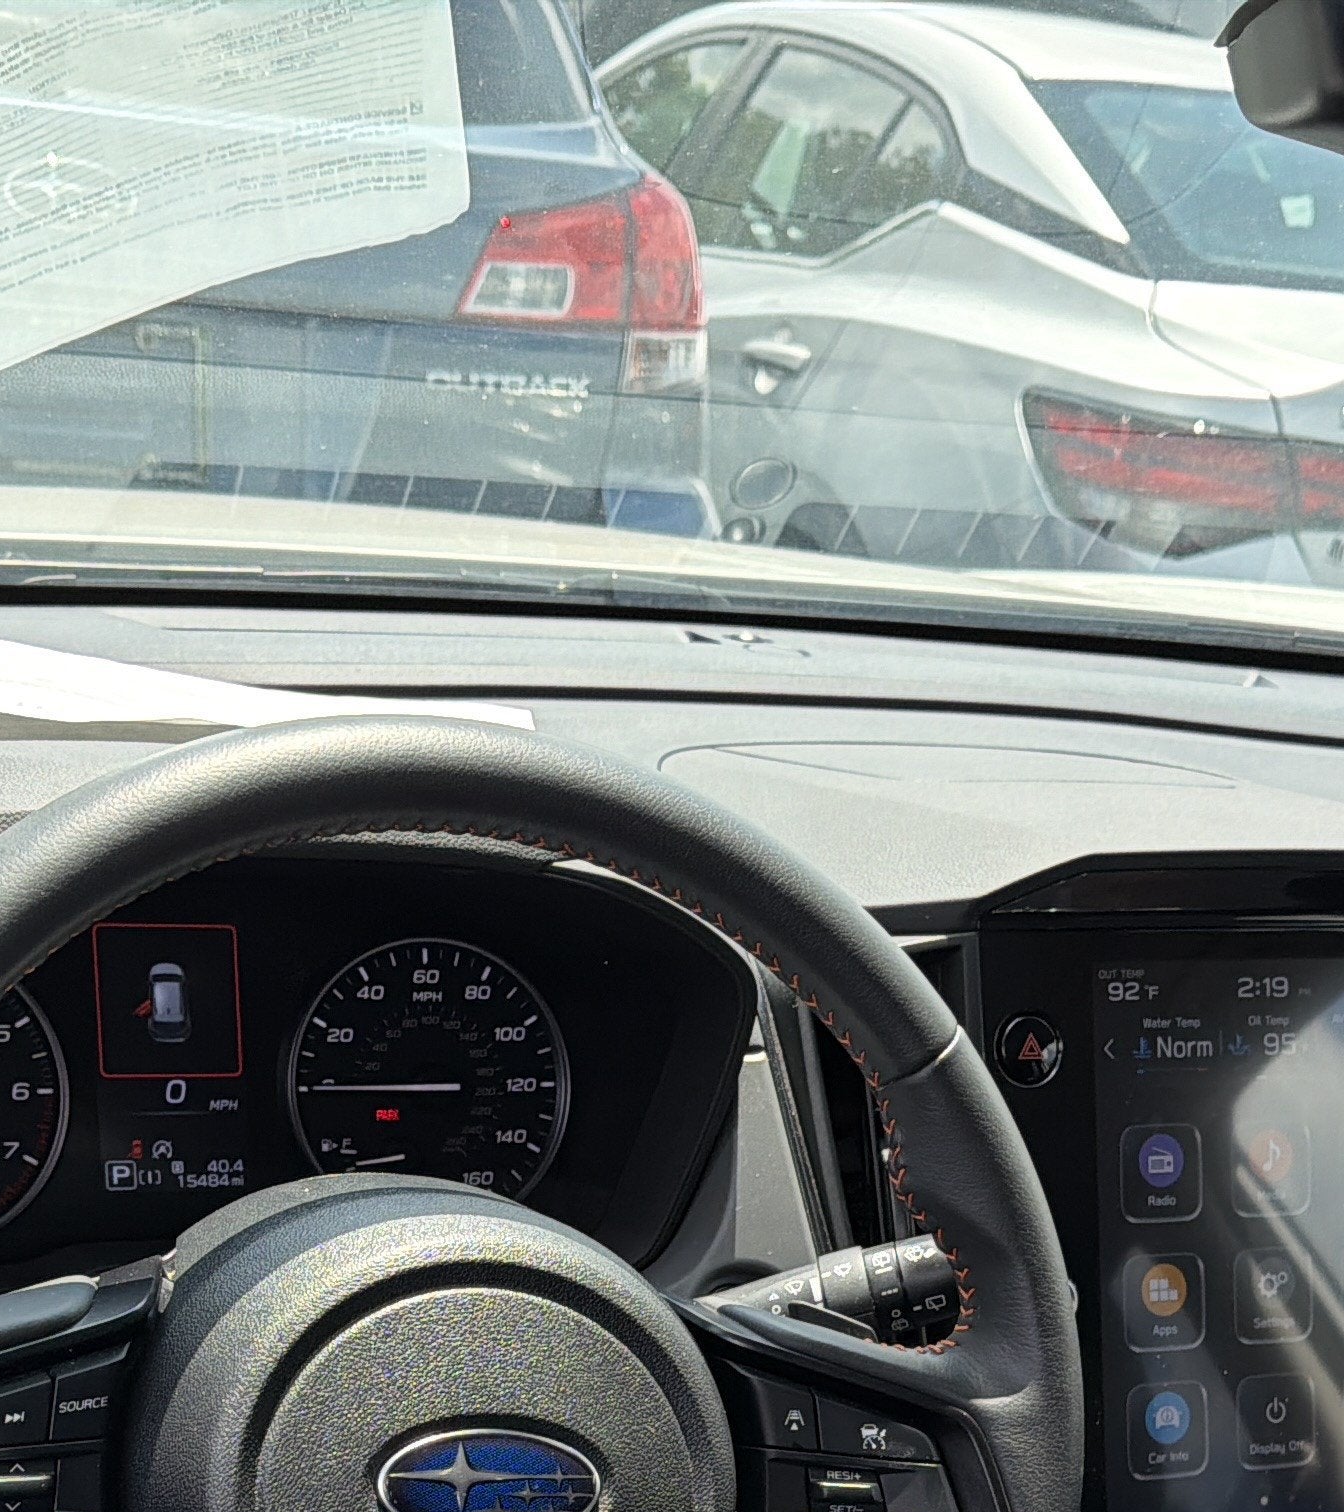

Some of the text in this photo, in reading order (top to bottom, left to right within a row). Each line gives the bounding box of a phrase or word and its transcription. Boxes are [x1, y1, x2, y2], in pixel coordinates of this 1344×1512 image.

[413, 969, 440, 984] 60
[1121, 968, 1146, 979] TEMP
[357, 985, 385, 1000] 40
[465, 985, 492, 1000] 80
[1107, 982, 1140, 1002] 92
[1237, 976, 1290, 998] 2:19
[413, 991, 443, 1003] MPH
[1142, 1017, 1201, 1030] Water Temp
[1248, 1015, 1290, 1028] Oil Temp
[327, 1028, 354, 1042] 20
[494, 1026, 526, 1042] 100
[1157, 1035, 1214, 1059] Norm
[11, 1082, 31, 1101] 6
[506, 1077, 537, 1092] 120
[165, 1079, 239, 1112] 0 MPH
[342, 1138, 352, 1149] F
[495, 1128, 527, 1144] 140
[3, 1141, 20, 1160] 7
[207, 1158, 245, 1173] 40.4
[112, 1165, 131, 1185] P
[462, 1170, 494, 1185] 160
[1147, 1195, 1177, 1207] Radio
[1152, 1324, 1179, 1337] Apps
[59, 1396, 108, 1413] SOURCE
[1249, 1441, 1286, 1457] Display
[1148, 1450, 1190, 1465] Car Info
